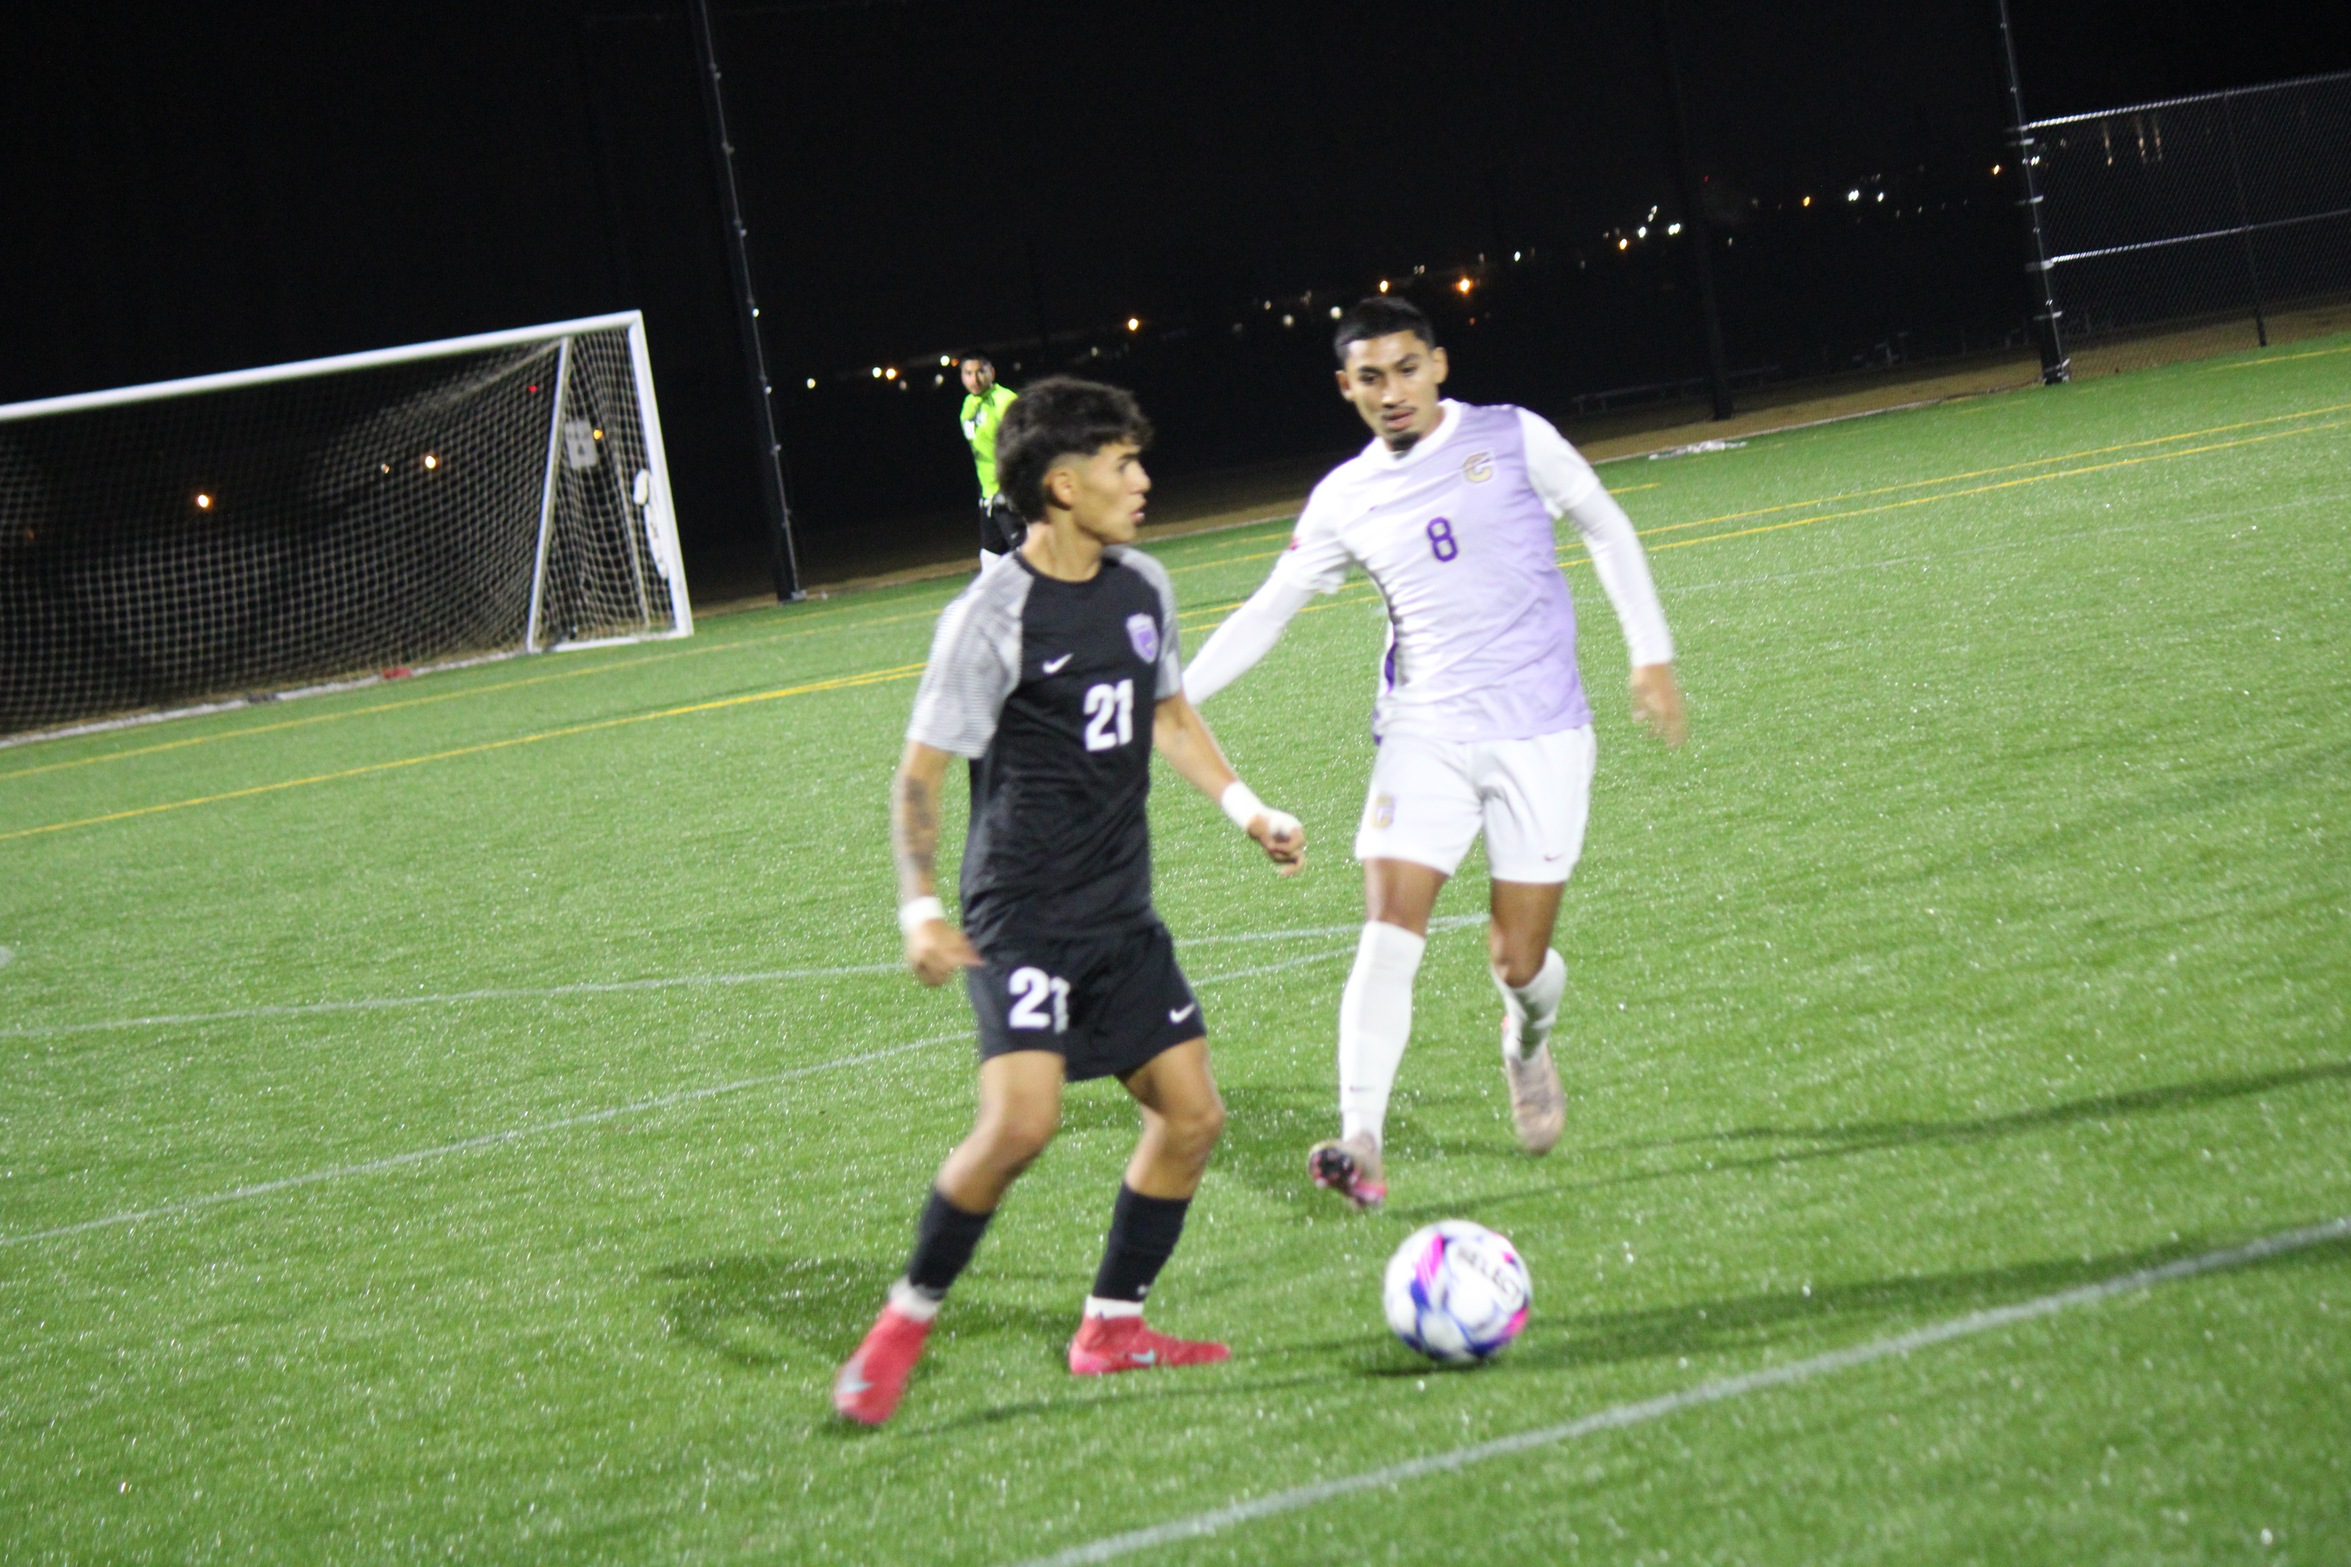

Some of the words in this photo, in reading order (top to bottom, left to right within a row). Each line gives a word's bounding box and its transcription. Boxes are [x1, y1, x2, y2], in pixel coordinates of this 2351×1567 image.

[1426, 516, 1458, 562] 8
[1083, 678, 1134, 752] 21
[1008, 965, 1071, 1035] 21
